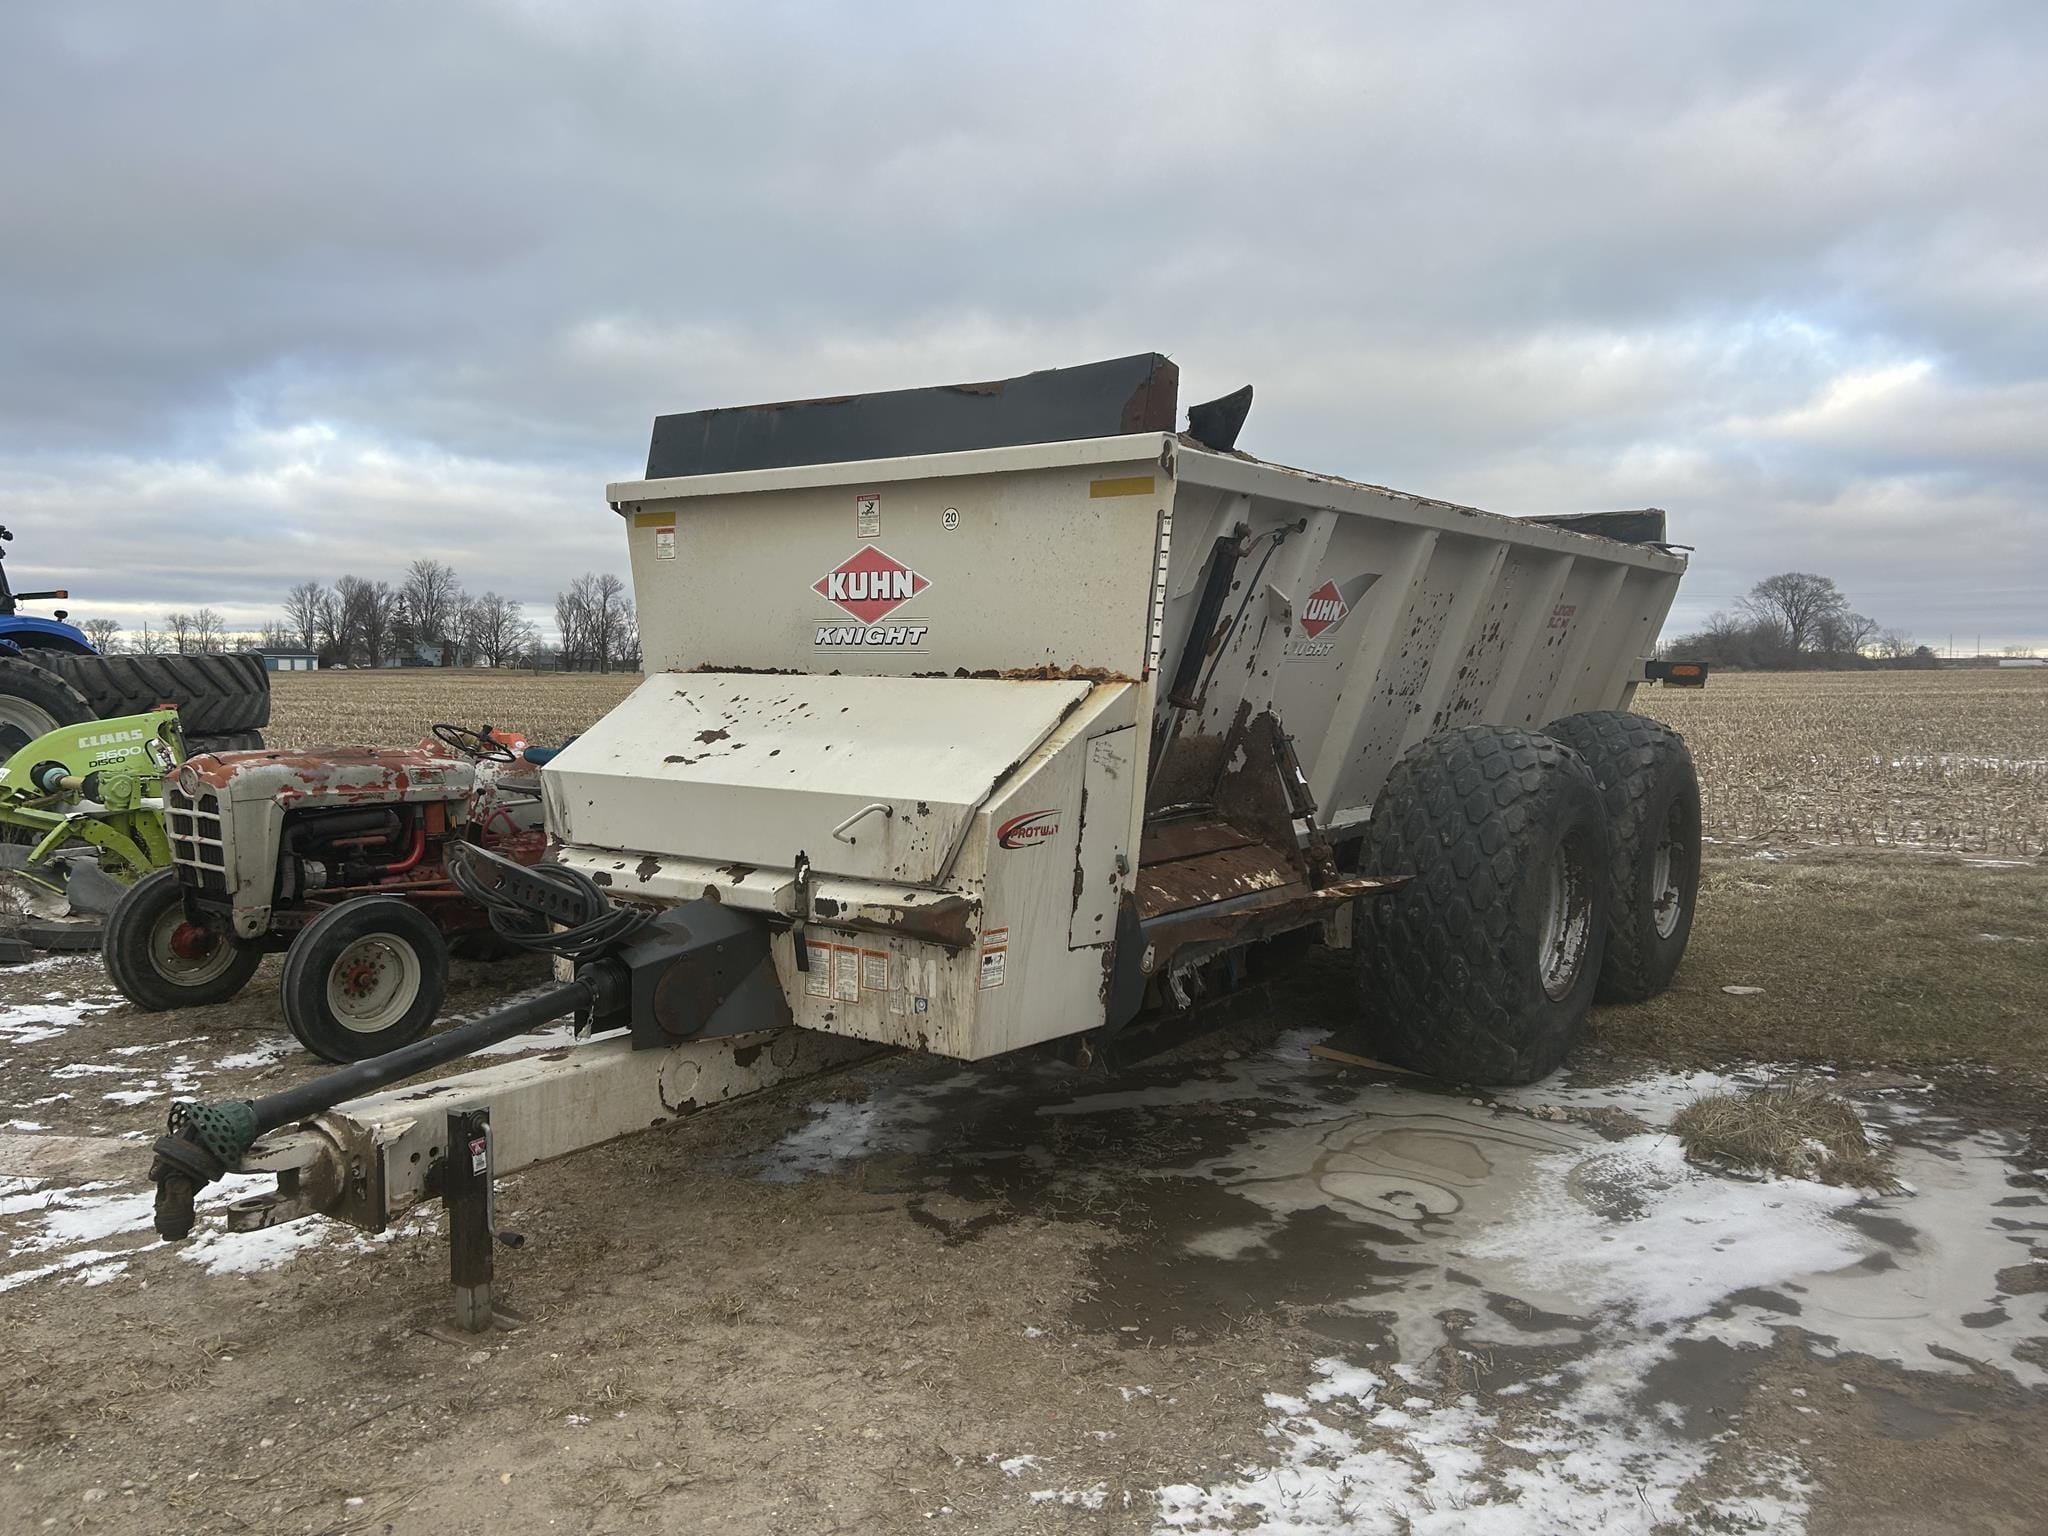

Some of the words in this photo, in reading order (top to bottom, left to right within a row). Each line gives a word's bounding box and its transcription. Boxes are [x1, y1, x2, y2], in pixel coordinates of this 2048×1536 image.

[945, 512, 957, 523] 20
[827, 570, 914, 601] KUHN
[815, 626, 928, 646] KNIGHT
[78, 729, 143, 749] CLAAS
[95, 746, 141, 760] 3600
[89, 756, 126, 768] DISCO
